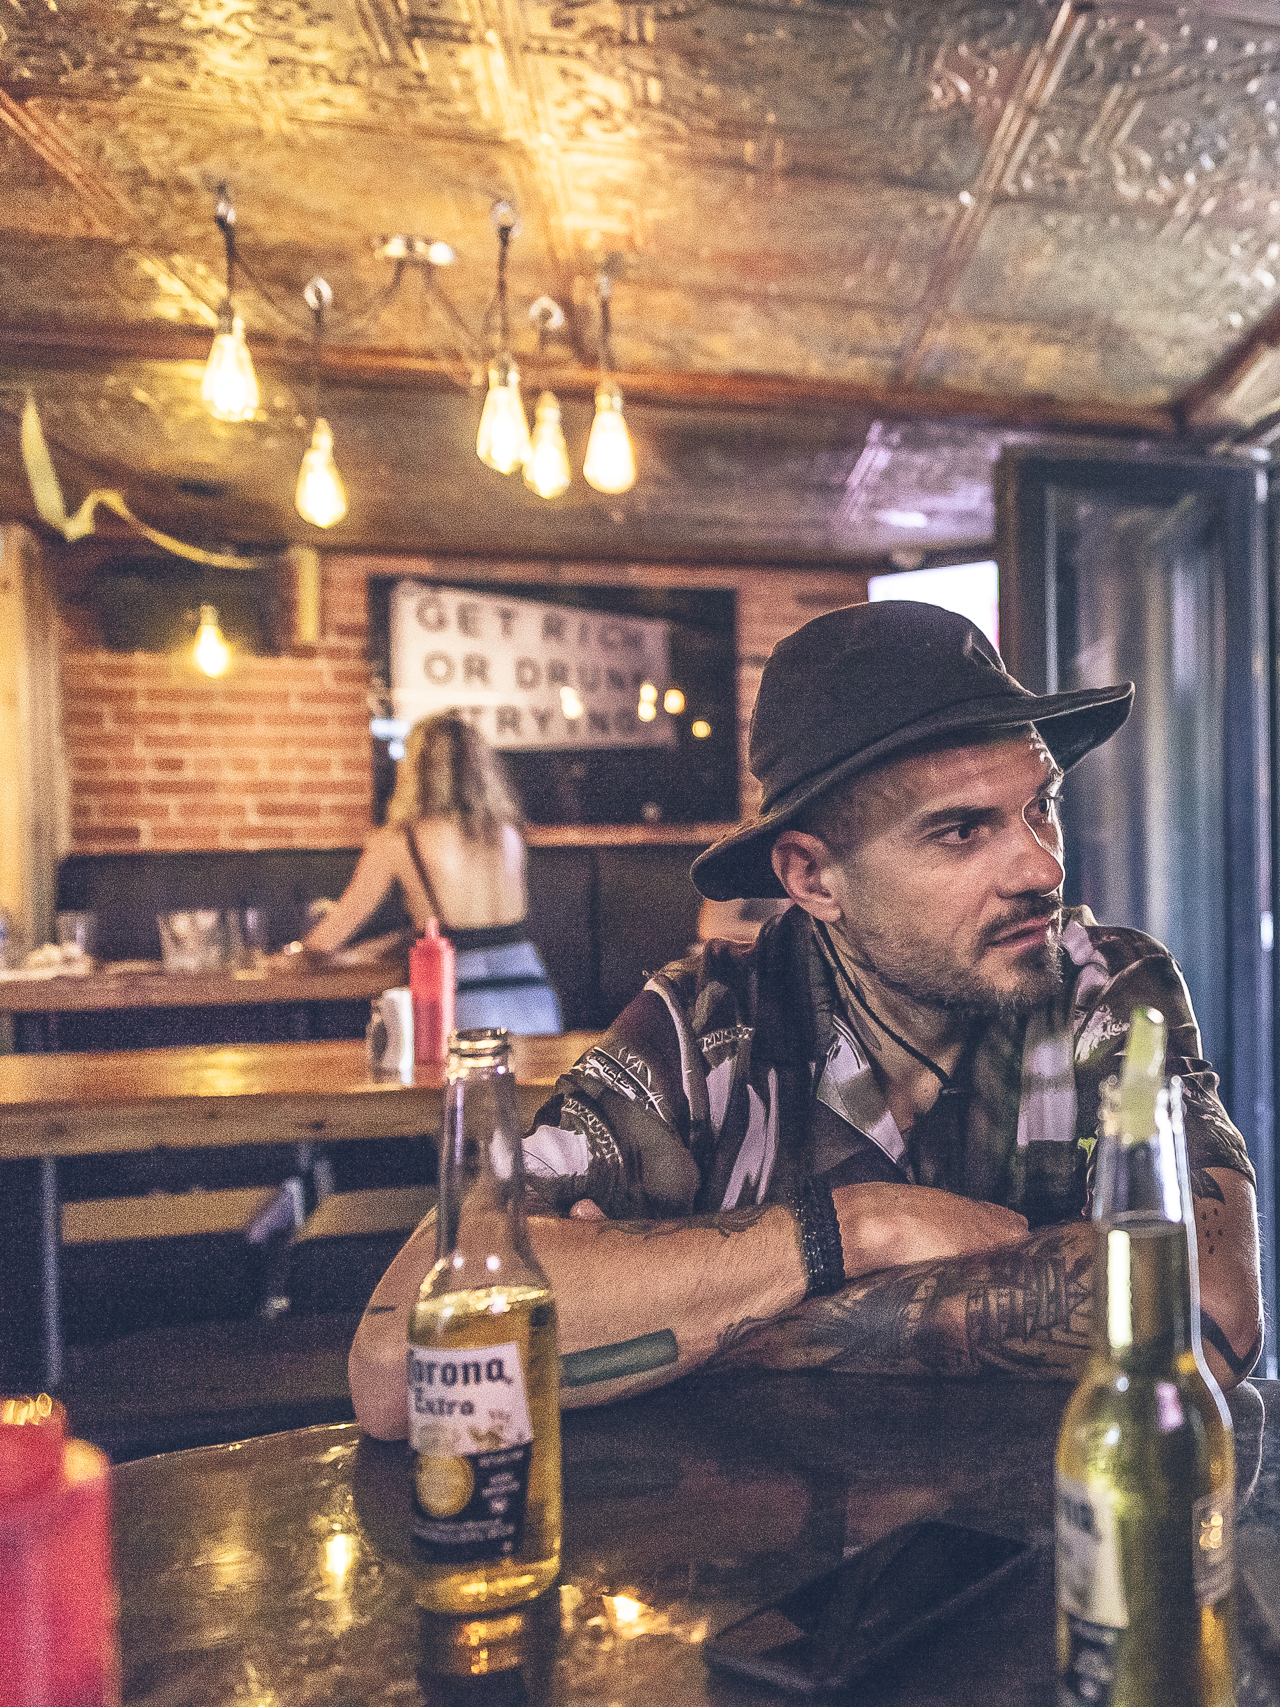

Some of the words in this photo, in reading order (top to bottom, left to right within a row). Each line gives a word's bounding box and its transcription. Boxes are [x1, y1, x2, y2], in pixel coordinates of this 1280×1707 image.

[415, 596, 518, 640] GET
[541, 612, 645, 653] RICH
[422, 650, 490, 687] OR
